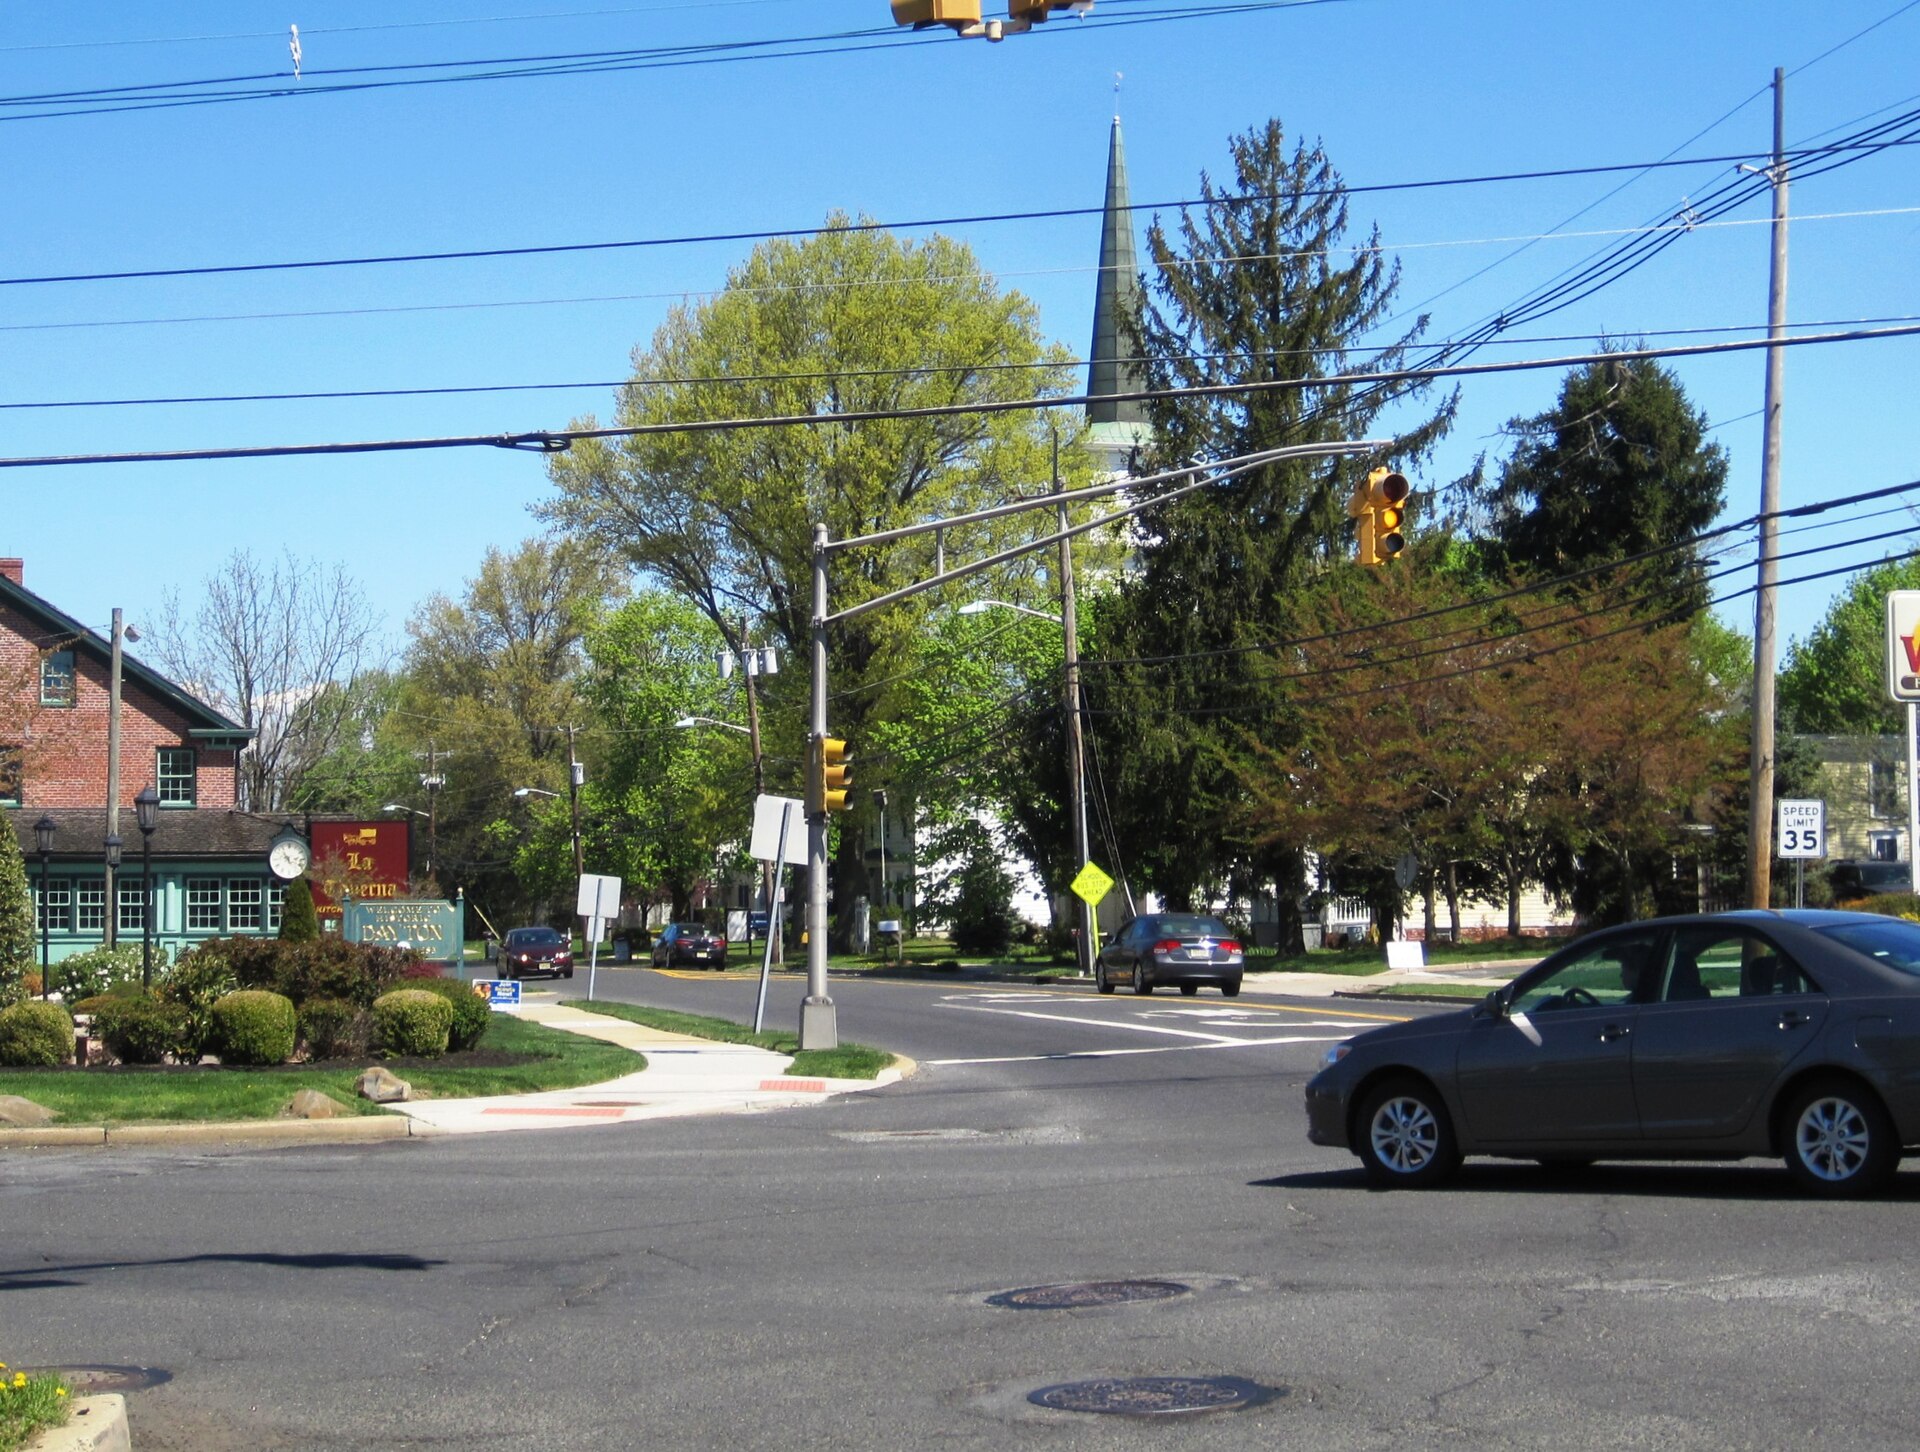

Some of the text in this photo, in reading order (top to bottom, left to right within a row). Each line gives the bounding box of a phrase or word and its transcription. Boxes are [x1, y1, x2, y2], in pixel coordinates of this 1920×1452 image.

[1783, 806, 1819, 816] SPEED
[1786, 818, 1815, 827] LIMIT
[1783, 830, 1818, 850] 35
[346, 852, 374, 871] La
[1079, 872, 1103, 881] SCHOOL
[1076, 879, 1107, 890] BUS STOP
[1083, 888, 1103, 896] AHEAD
[362, 924, 443, 942] DAYTON
